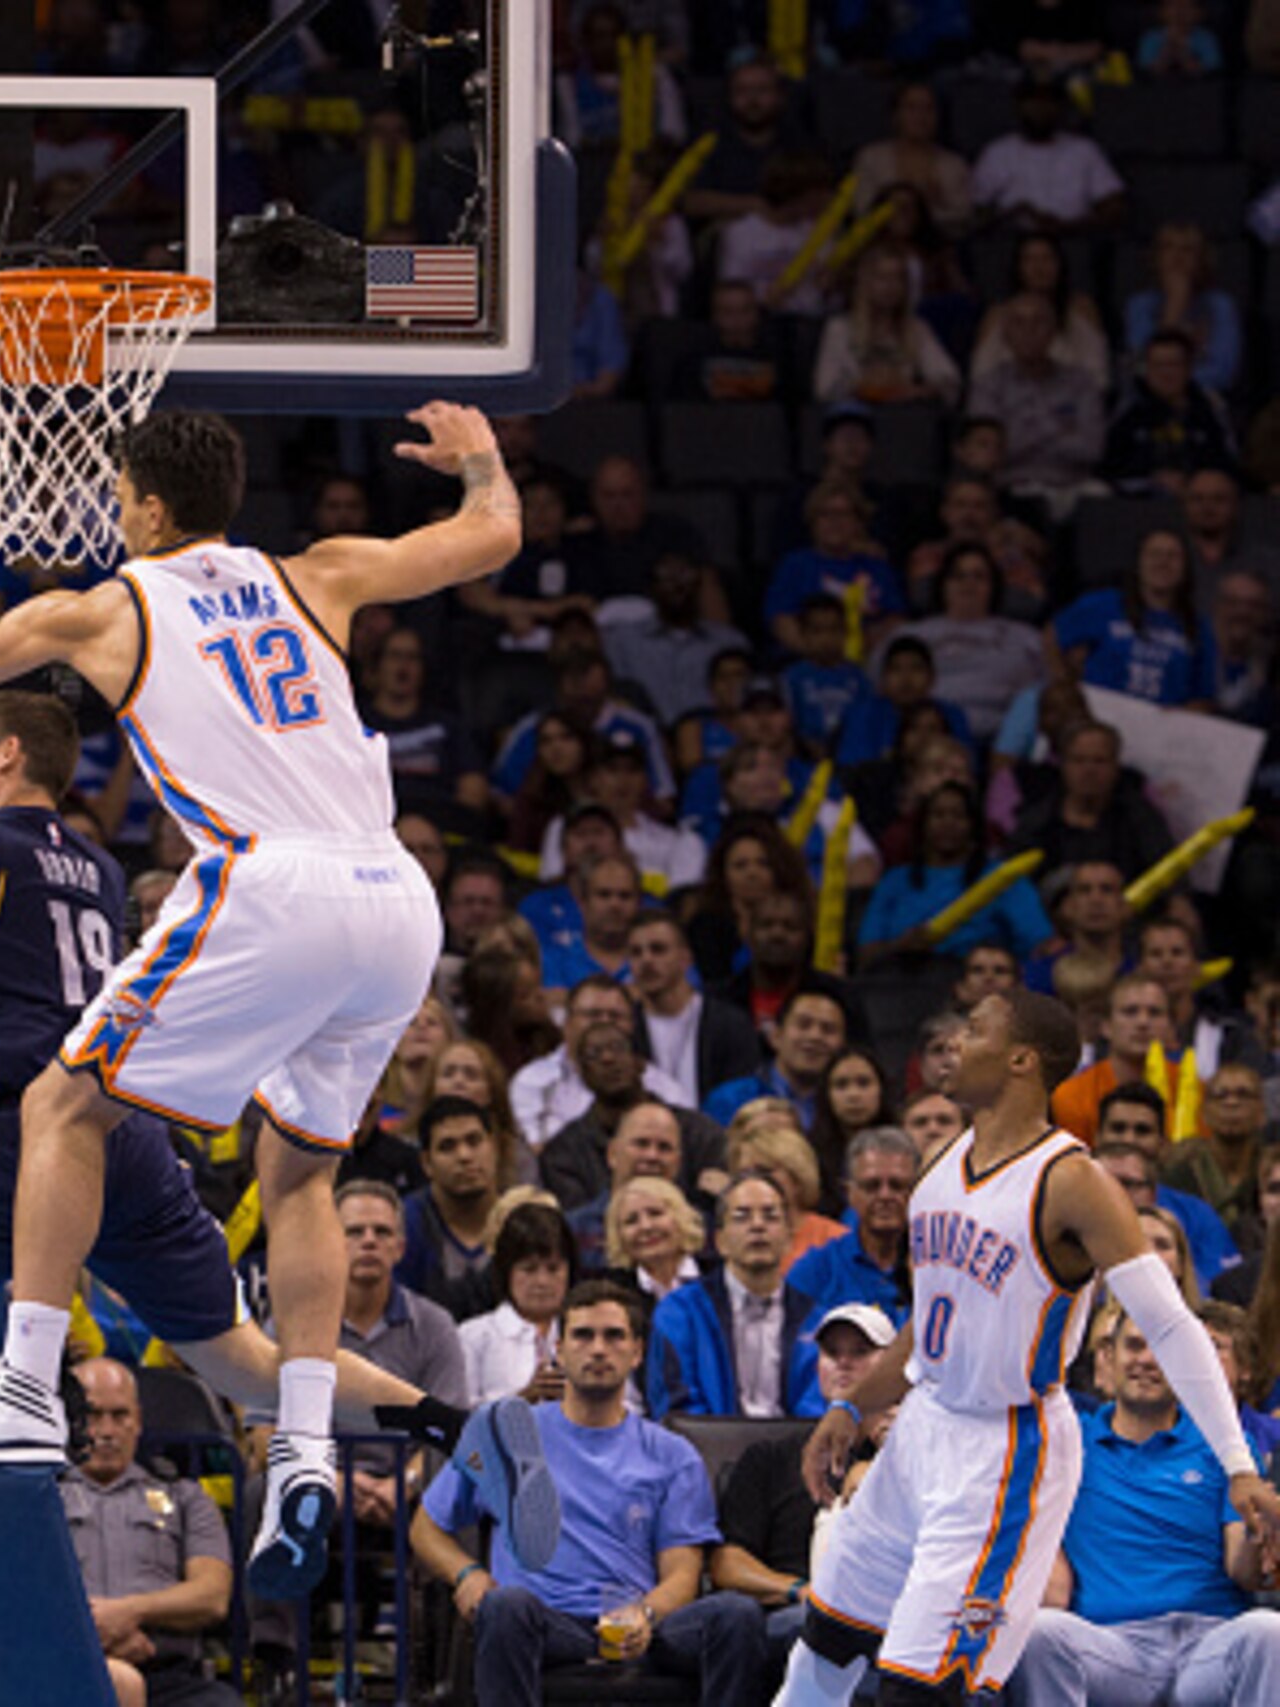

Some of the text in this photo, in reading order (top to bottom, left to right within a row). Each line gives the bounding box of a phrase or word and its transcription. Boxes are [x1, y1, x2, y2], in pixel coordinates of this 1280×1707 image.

[196, 621, 327, 734] 12
[46, 899, 116, 1007] 19
[923, 1292, 957, 1363] 0
